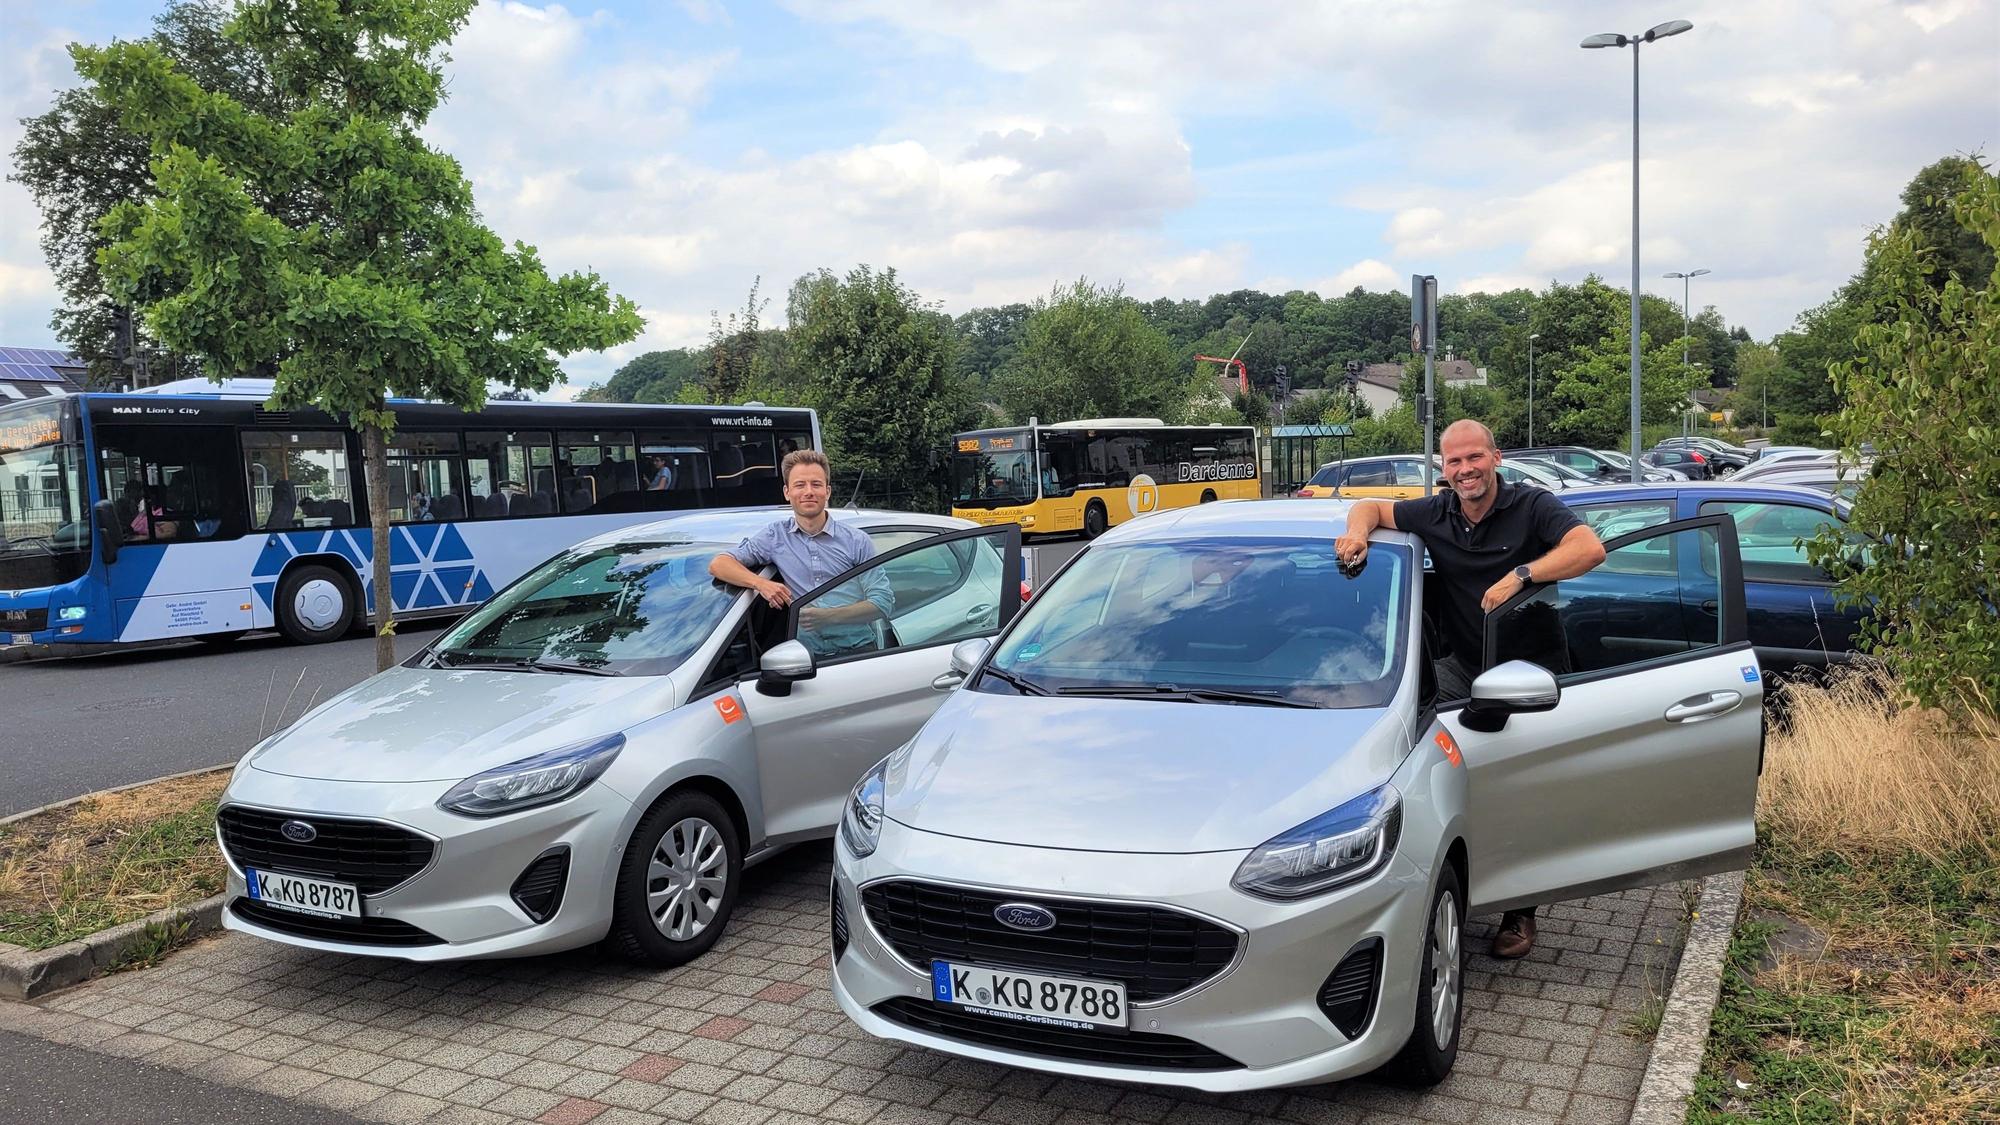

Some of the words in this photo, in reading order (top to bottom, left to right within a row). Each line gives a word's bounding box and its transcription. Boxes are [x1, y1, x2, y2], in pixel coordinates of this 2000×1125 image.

[179, 407, 200, 416] City
[711, 416, 773, 427] www.vrt-info.de
[1178, 460, 1255, 482] Dardenne
[258, 873, 274, 899] K
[309, 882, 355, 913] 8787
[1007, 908, 1041, 926] Ford
[940, 985, 947, 995] D
[952, 968, 973, 1001] K
[1040, 981, 1121, 1021] 8788
